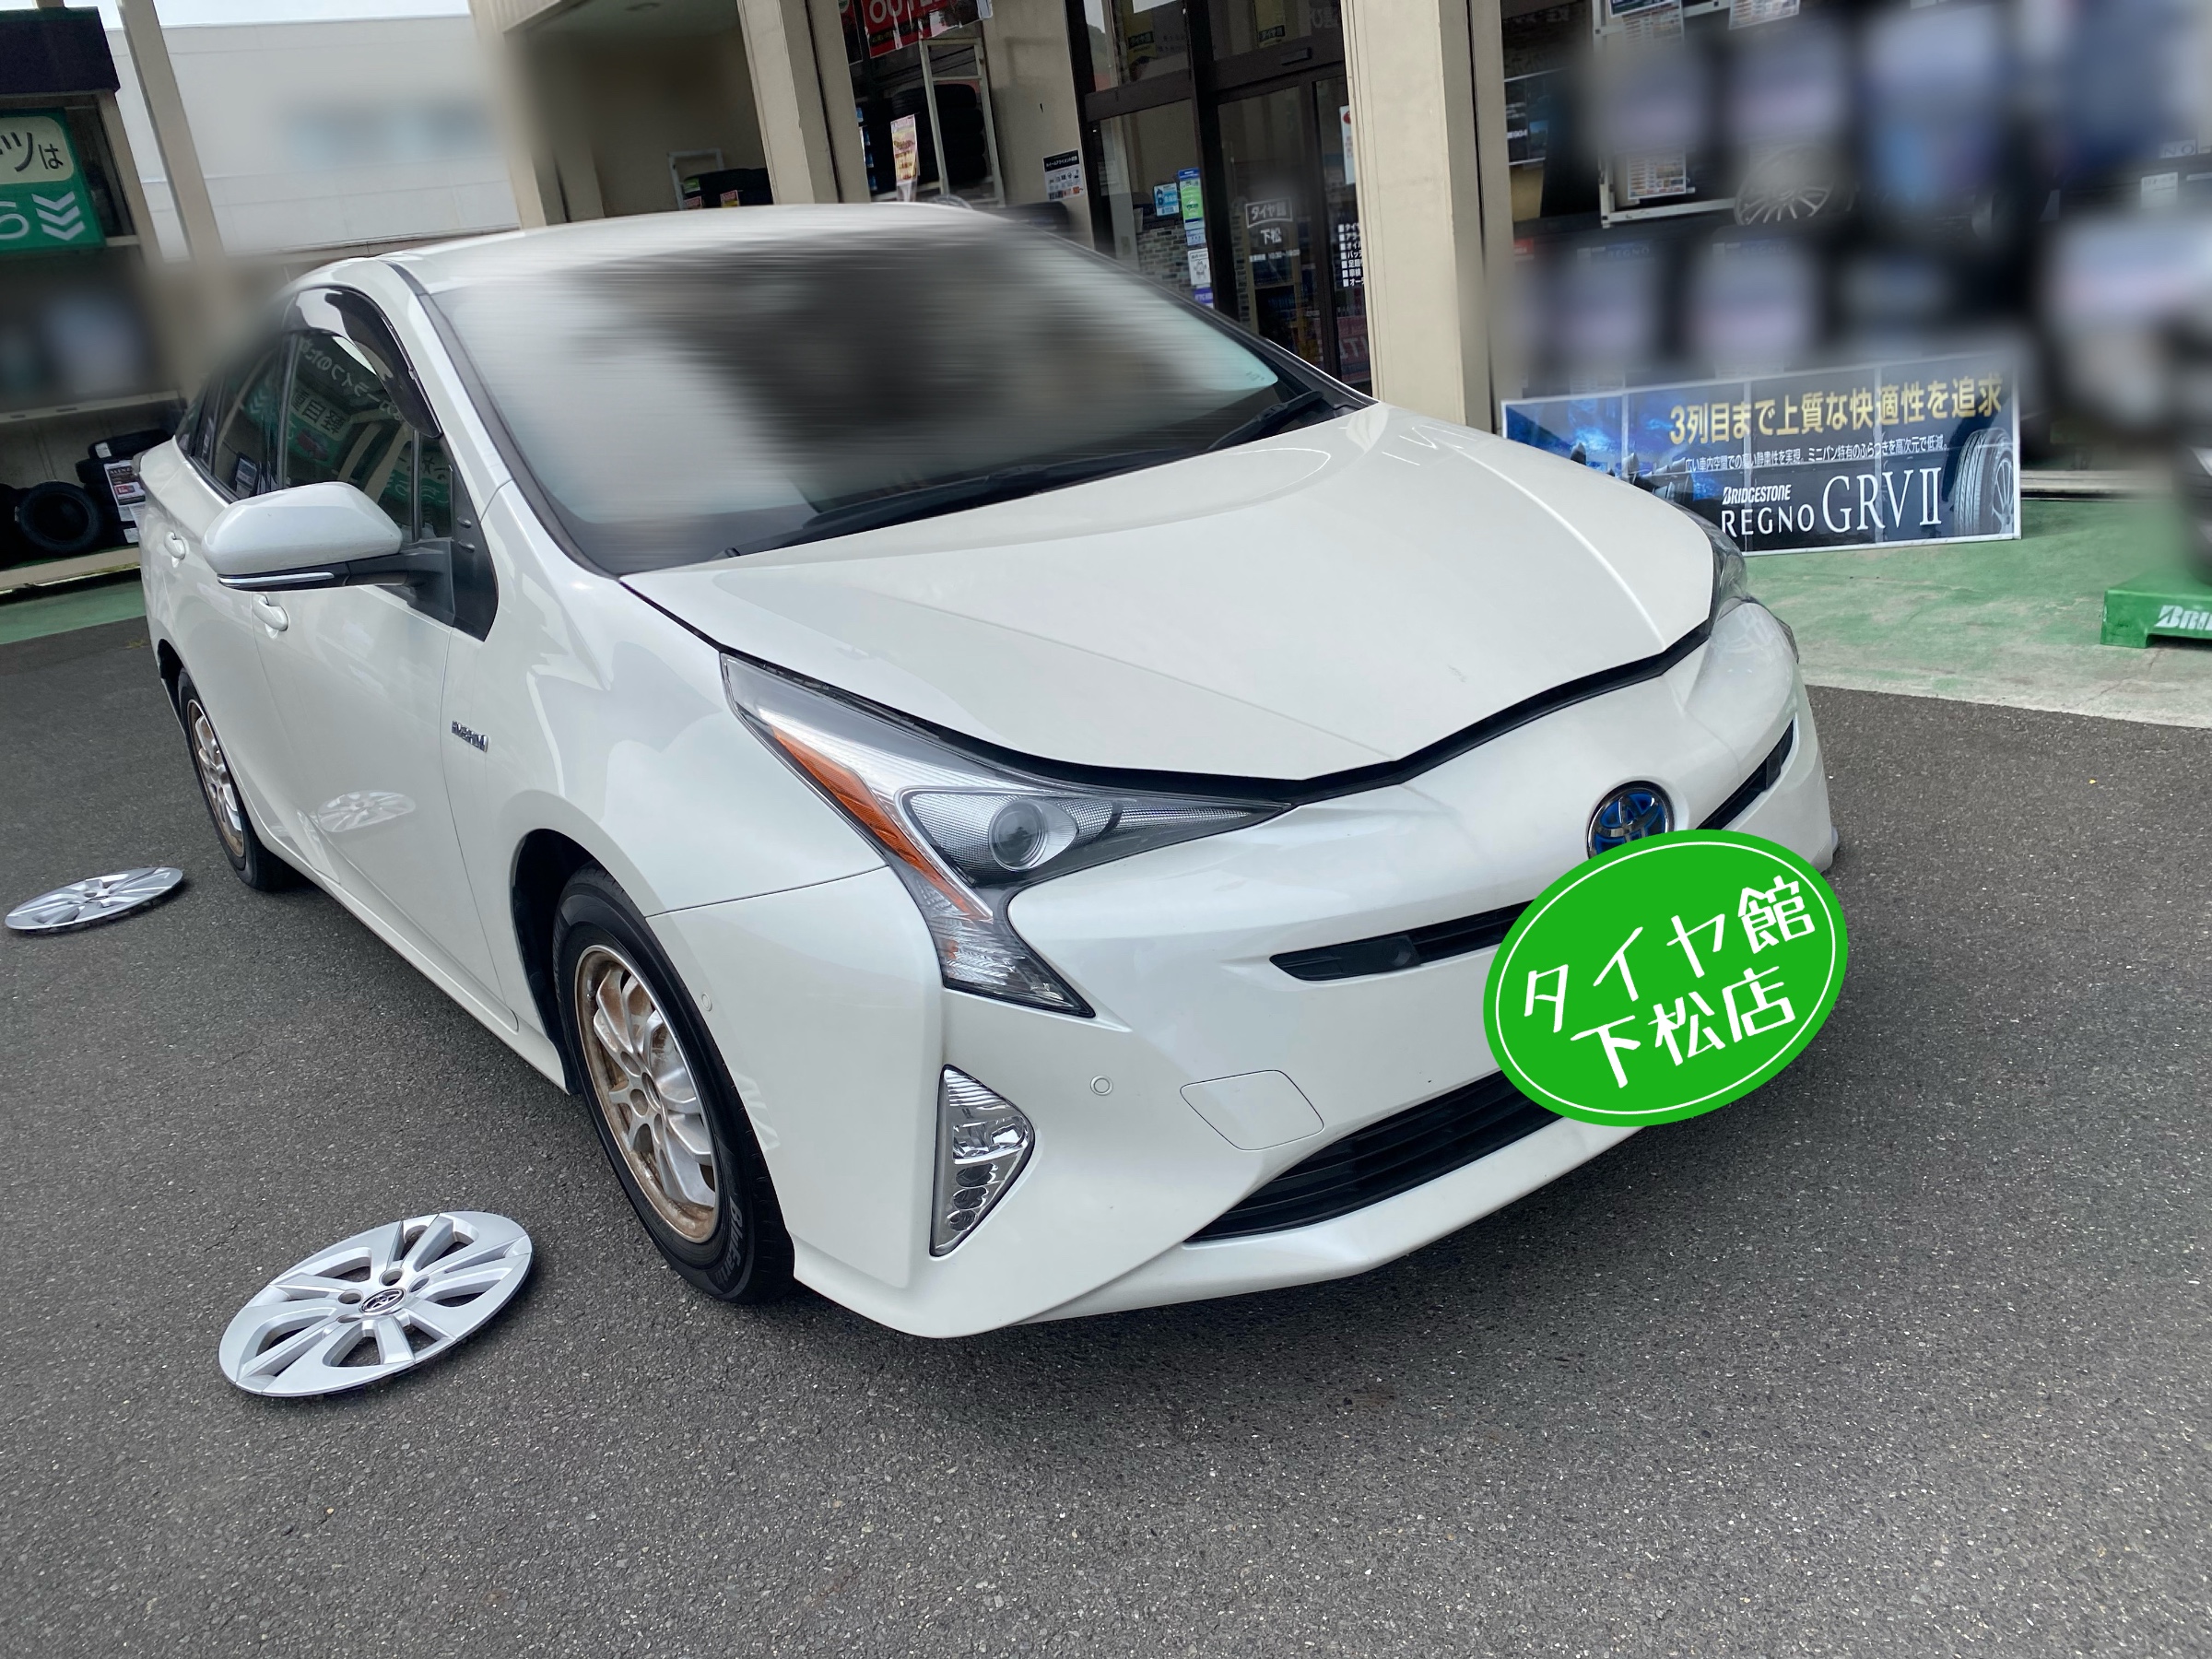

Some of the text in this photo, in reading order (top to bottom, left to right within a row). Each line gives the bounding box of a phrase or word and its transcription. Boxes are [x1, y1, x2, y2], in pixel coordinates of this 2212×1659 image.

[0, 131, 64, 172] ツは
[1669, 372, 2003, 444] 3列目まで上質な快適性を追求
[1722, 484, 1793, 506] BRIDGESTONE
[1721, 503, 1816, 538] REGNO
